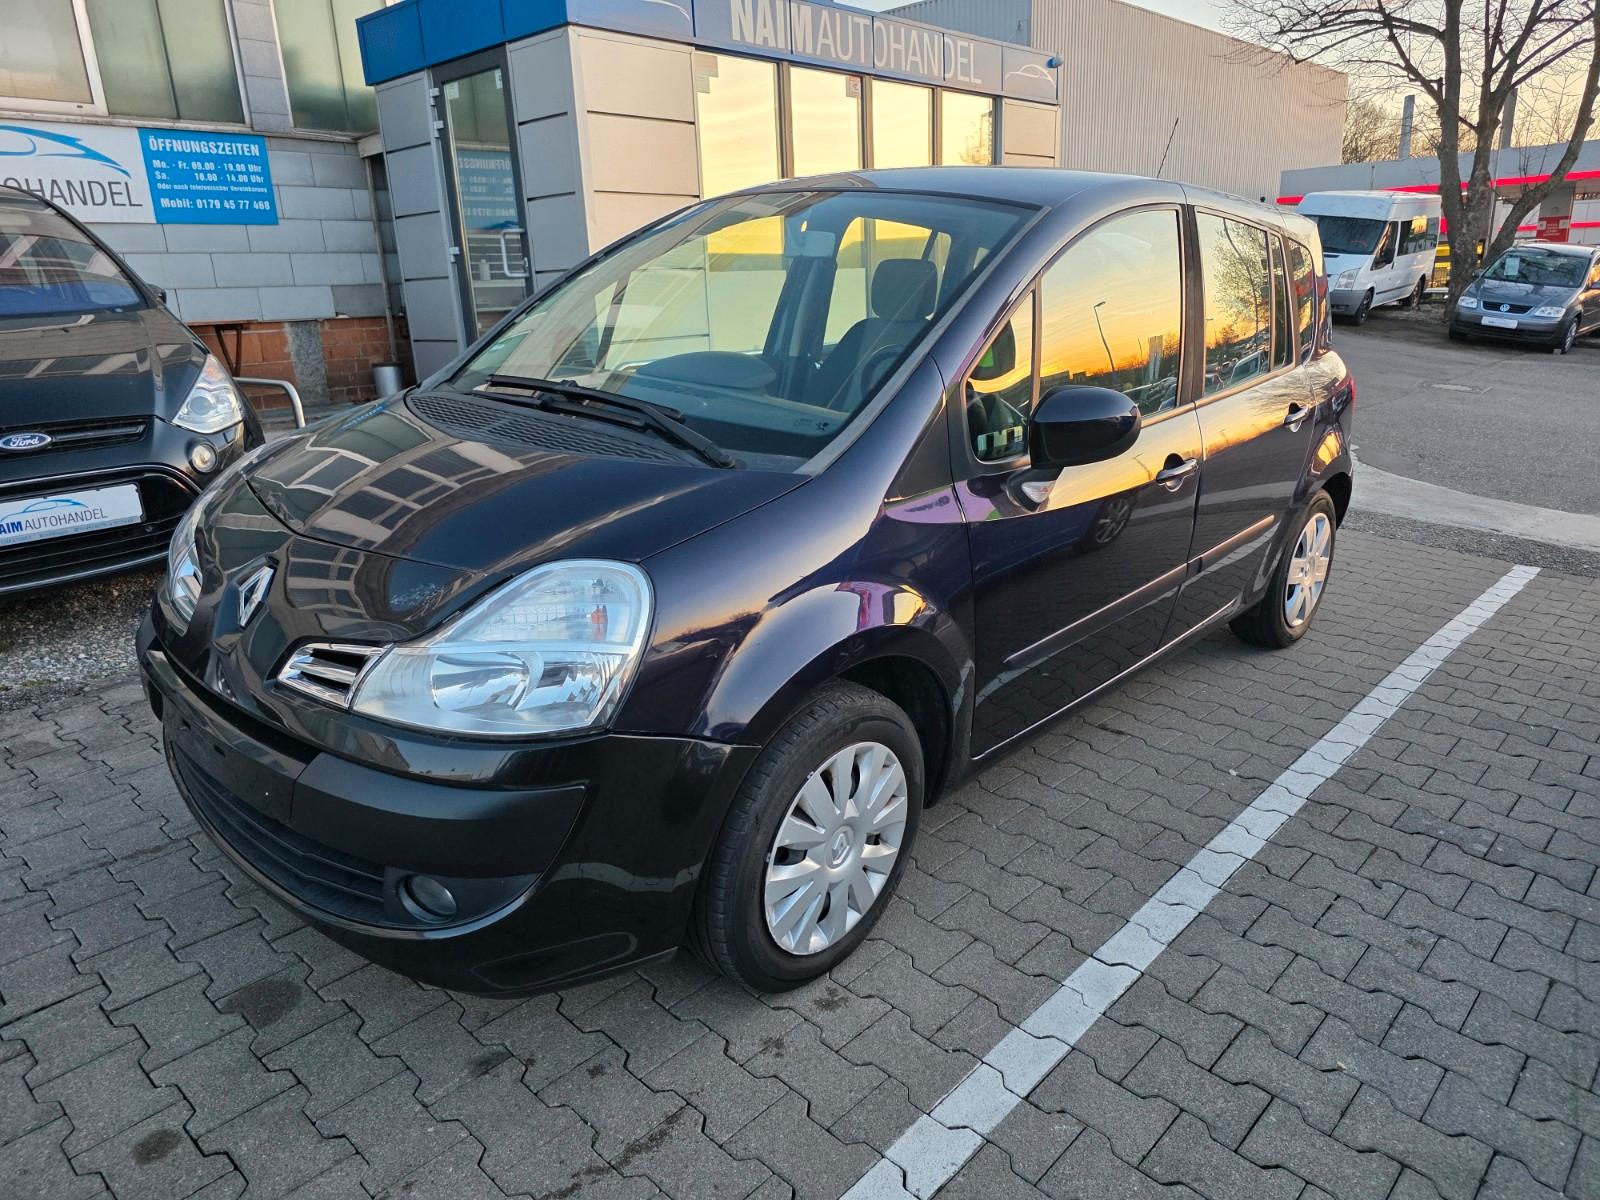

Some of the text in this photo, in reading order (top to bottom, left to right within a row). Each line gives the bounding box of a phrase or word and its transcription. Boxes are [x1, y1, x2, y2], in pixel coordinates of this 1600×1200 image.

[731, 0, 982, 85] NAIM AUTOHANDEL
[149, 136, 260, 157] ÖFFNUNGSZEITEN
[152, 159, 170, 169] Mo.
[177, 160, 190, 170] Fr.
[247, 164, 262, 173] Uhr
[154, 170, 170, 180] Sa.
[250, 175, 265, 184] Uhr
[160, 197, 194, 209] Mobil:
[195, 198, 221, 210] 0179
[223, 200, 236, 210] 45
[237, 200, 250, 210] 77
[9, 436, 40, 447] Ford
[24, 507, 109, 531] AUTOHANDEL
